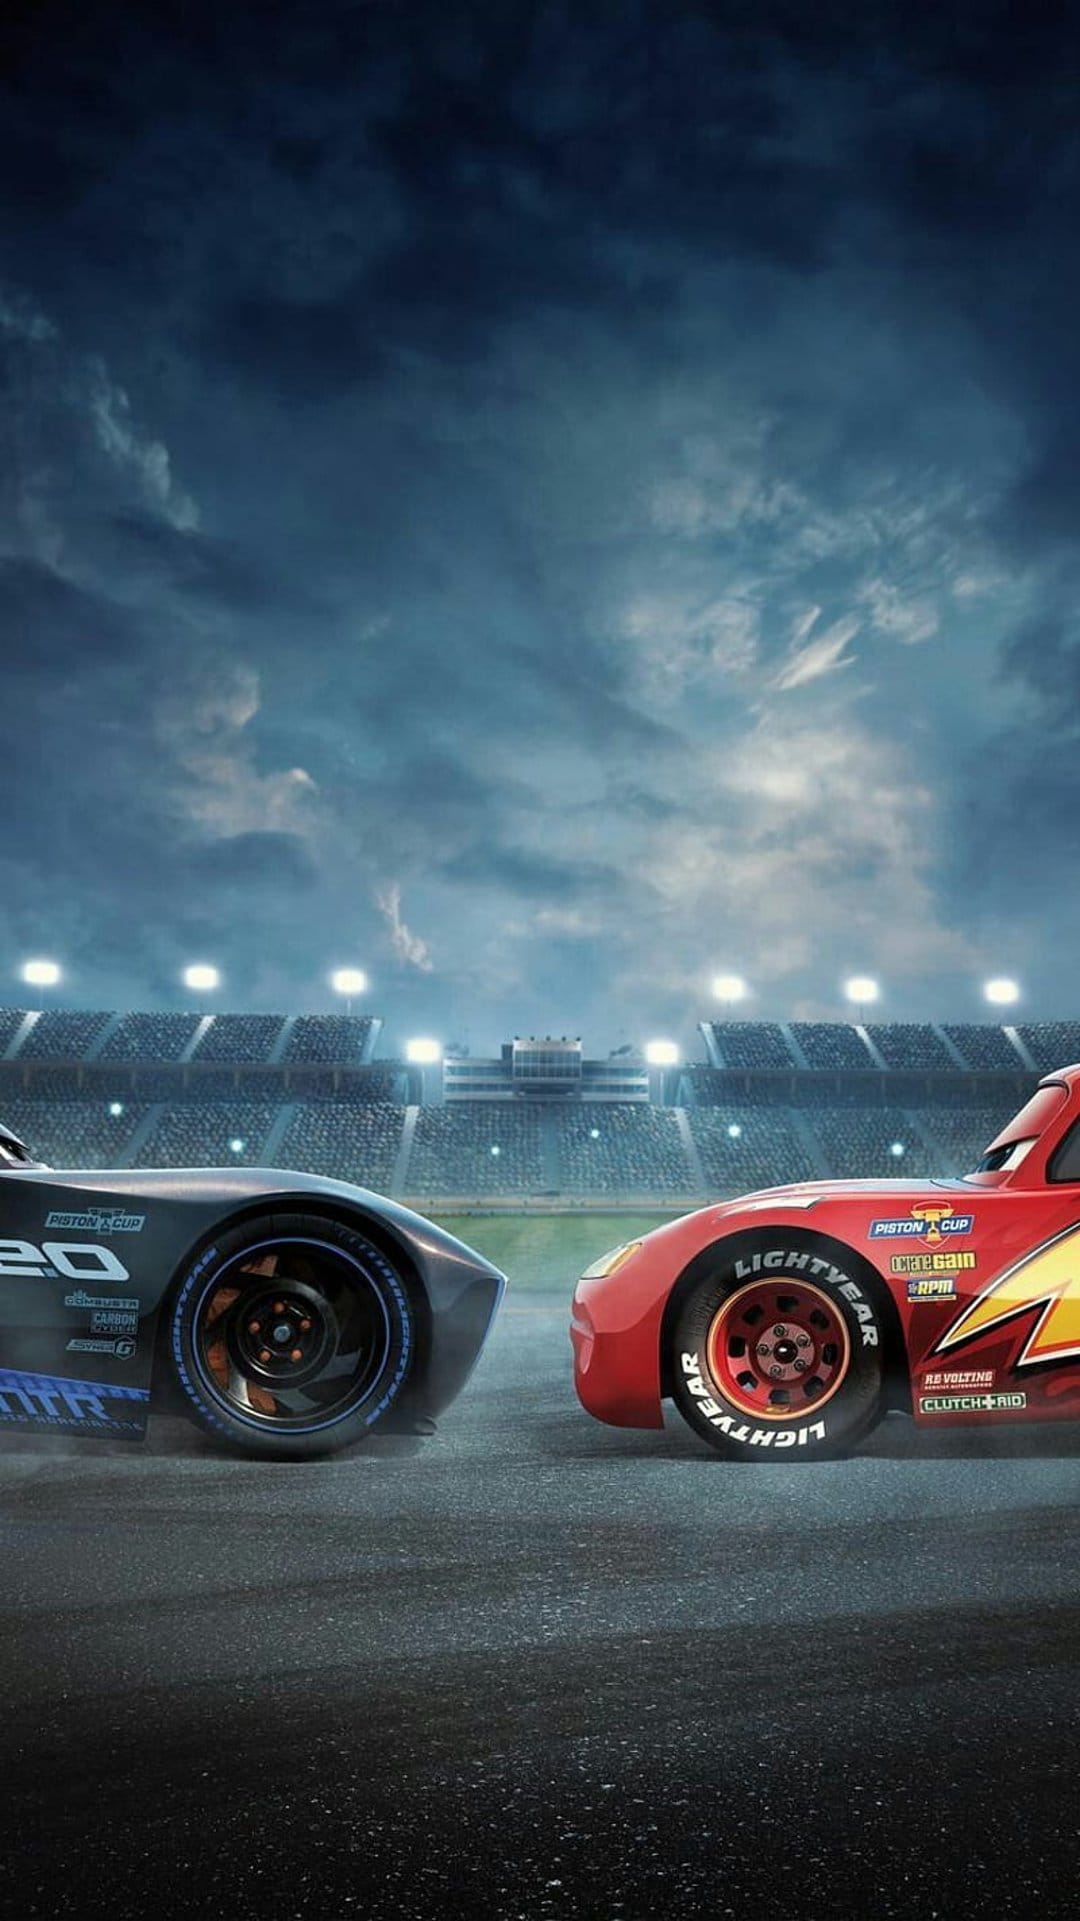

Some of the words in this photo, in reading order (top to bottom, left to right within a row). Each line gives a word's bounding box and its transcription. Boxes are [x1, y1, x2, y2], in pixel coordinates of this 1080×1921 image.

[50, 1215, 98, 1228] PISTON
[112, 1217, 141, 1230] CUP
[874, 1221, 924, 1235] PISTON
[941, 1219, 969, 1231] CUP
[734, 1250, 879, 1348] LIGHTYEAR
[94, 1311, 136, 1325] CARBON
[943, 1371, 993, 1384] VOLTING
[680, 1351, 827, 1448] LIGHTYEAR
[924, 1397, 981, 1411] CLUTCH
